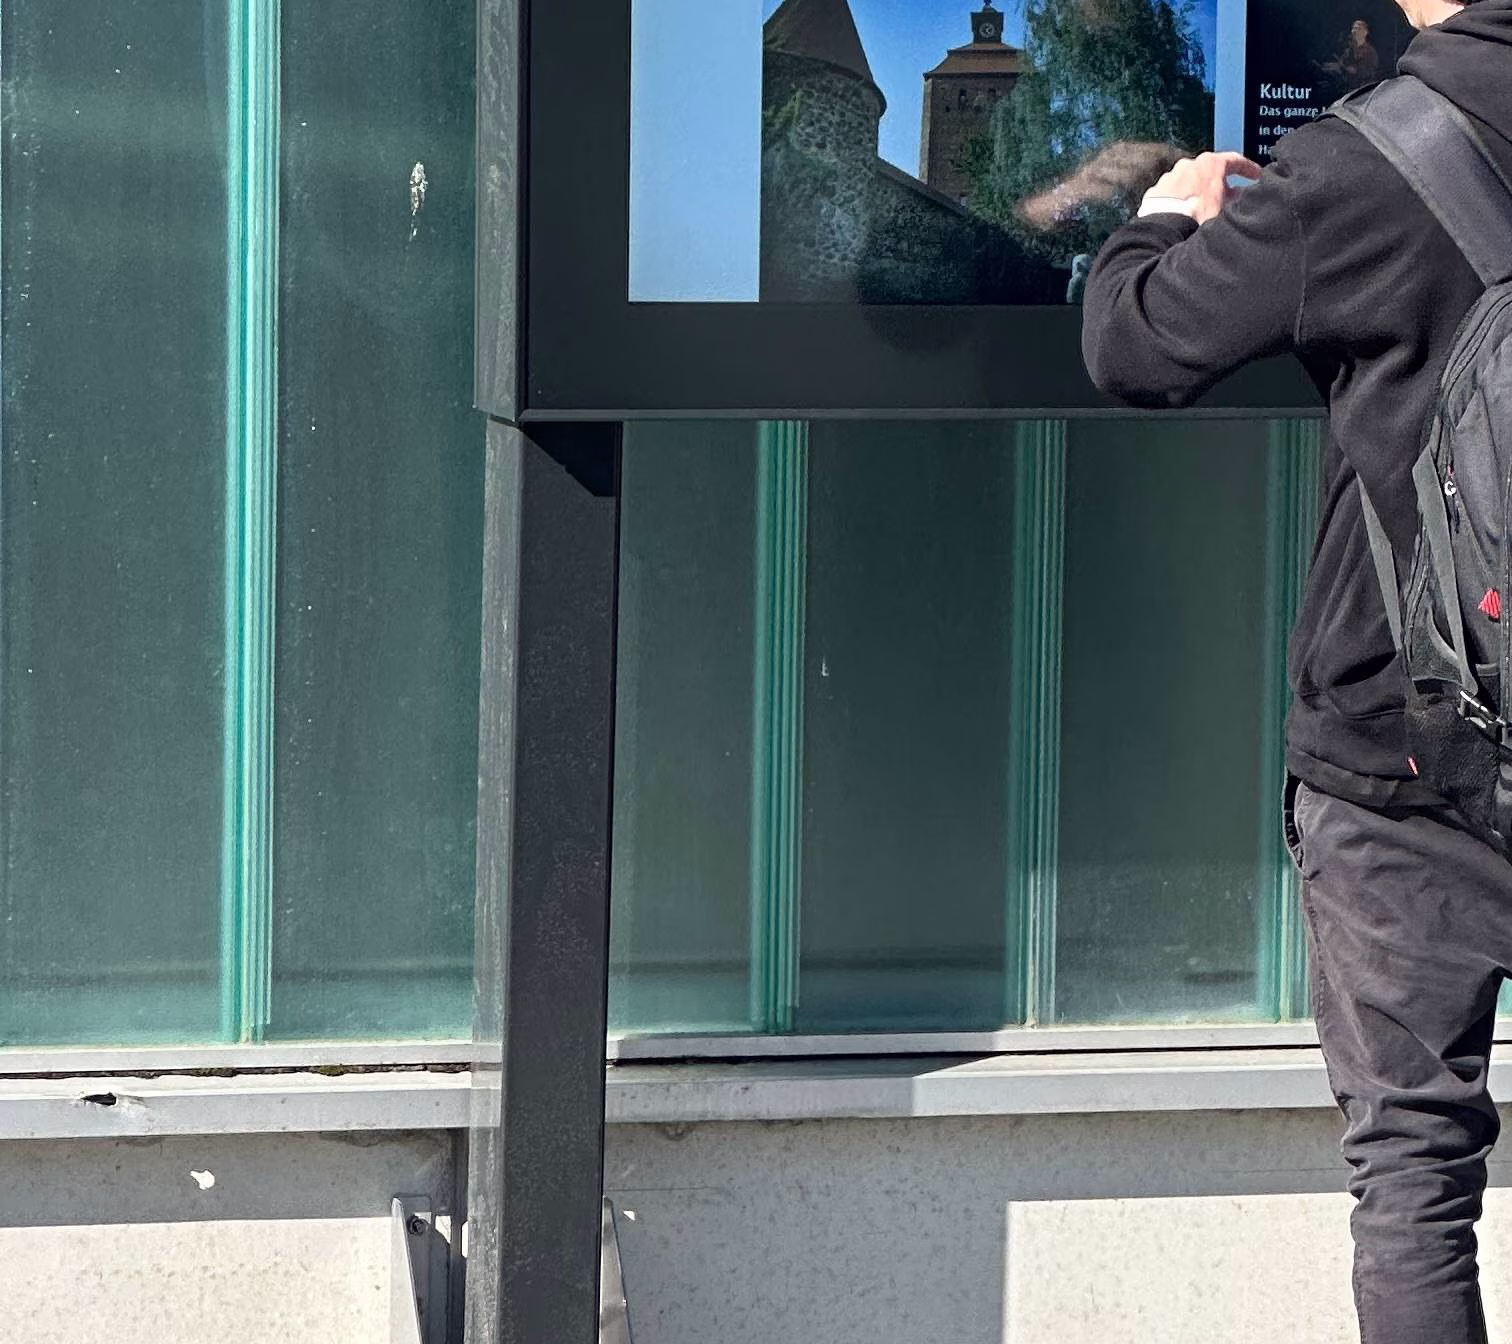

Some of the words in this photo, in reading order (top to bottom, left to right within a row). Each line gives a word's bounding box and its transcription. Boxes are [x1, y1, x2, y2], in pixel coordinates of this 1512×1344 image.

[1259, 83, 1312, 100] Kultur
[1259, 106, 1281, 117] Das
[1258, 124, 1271, 136] in
